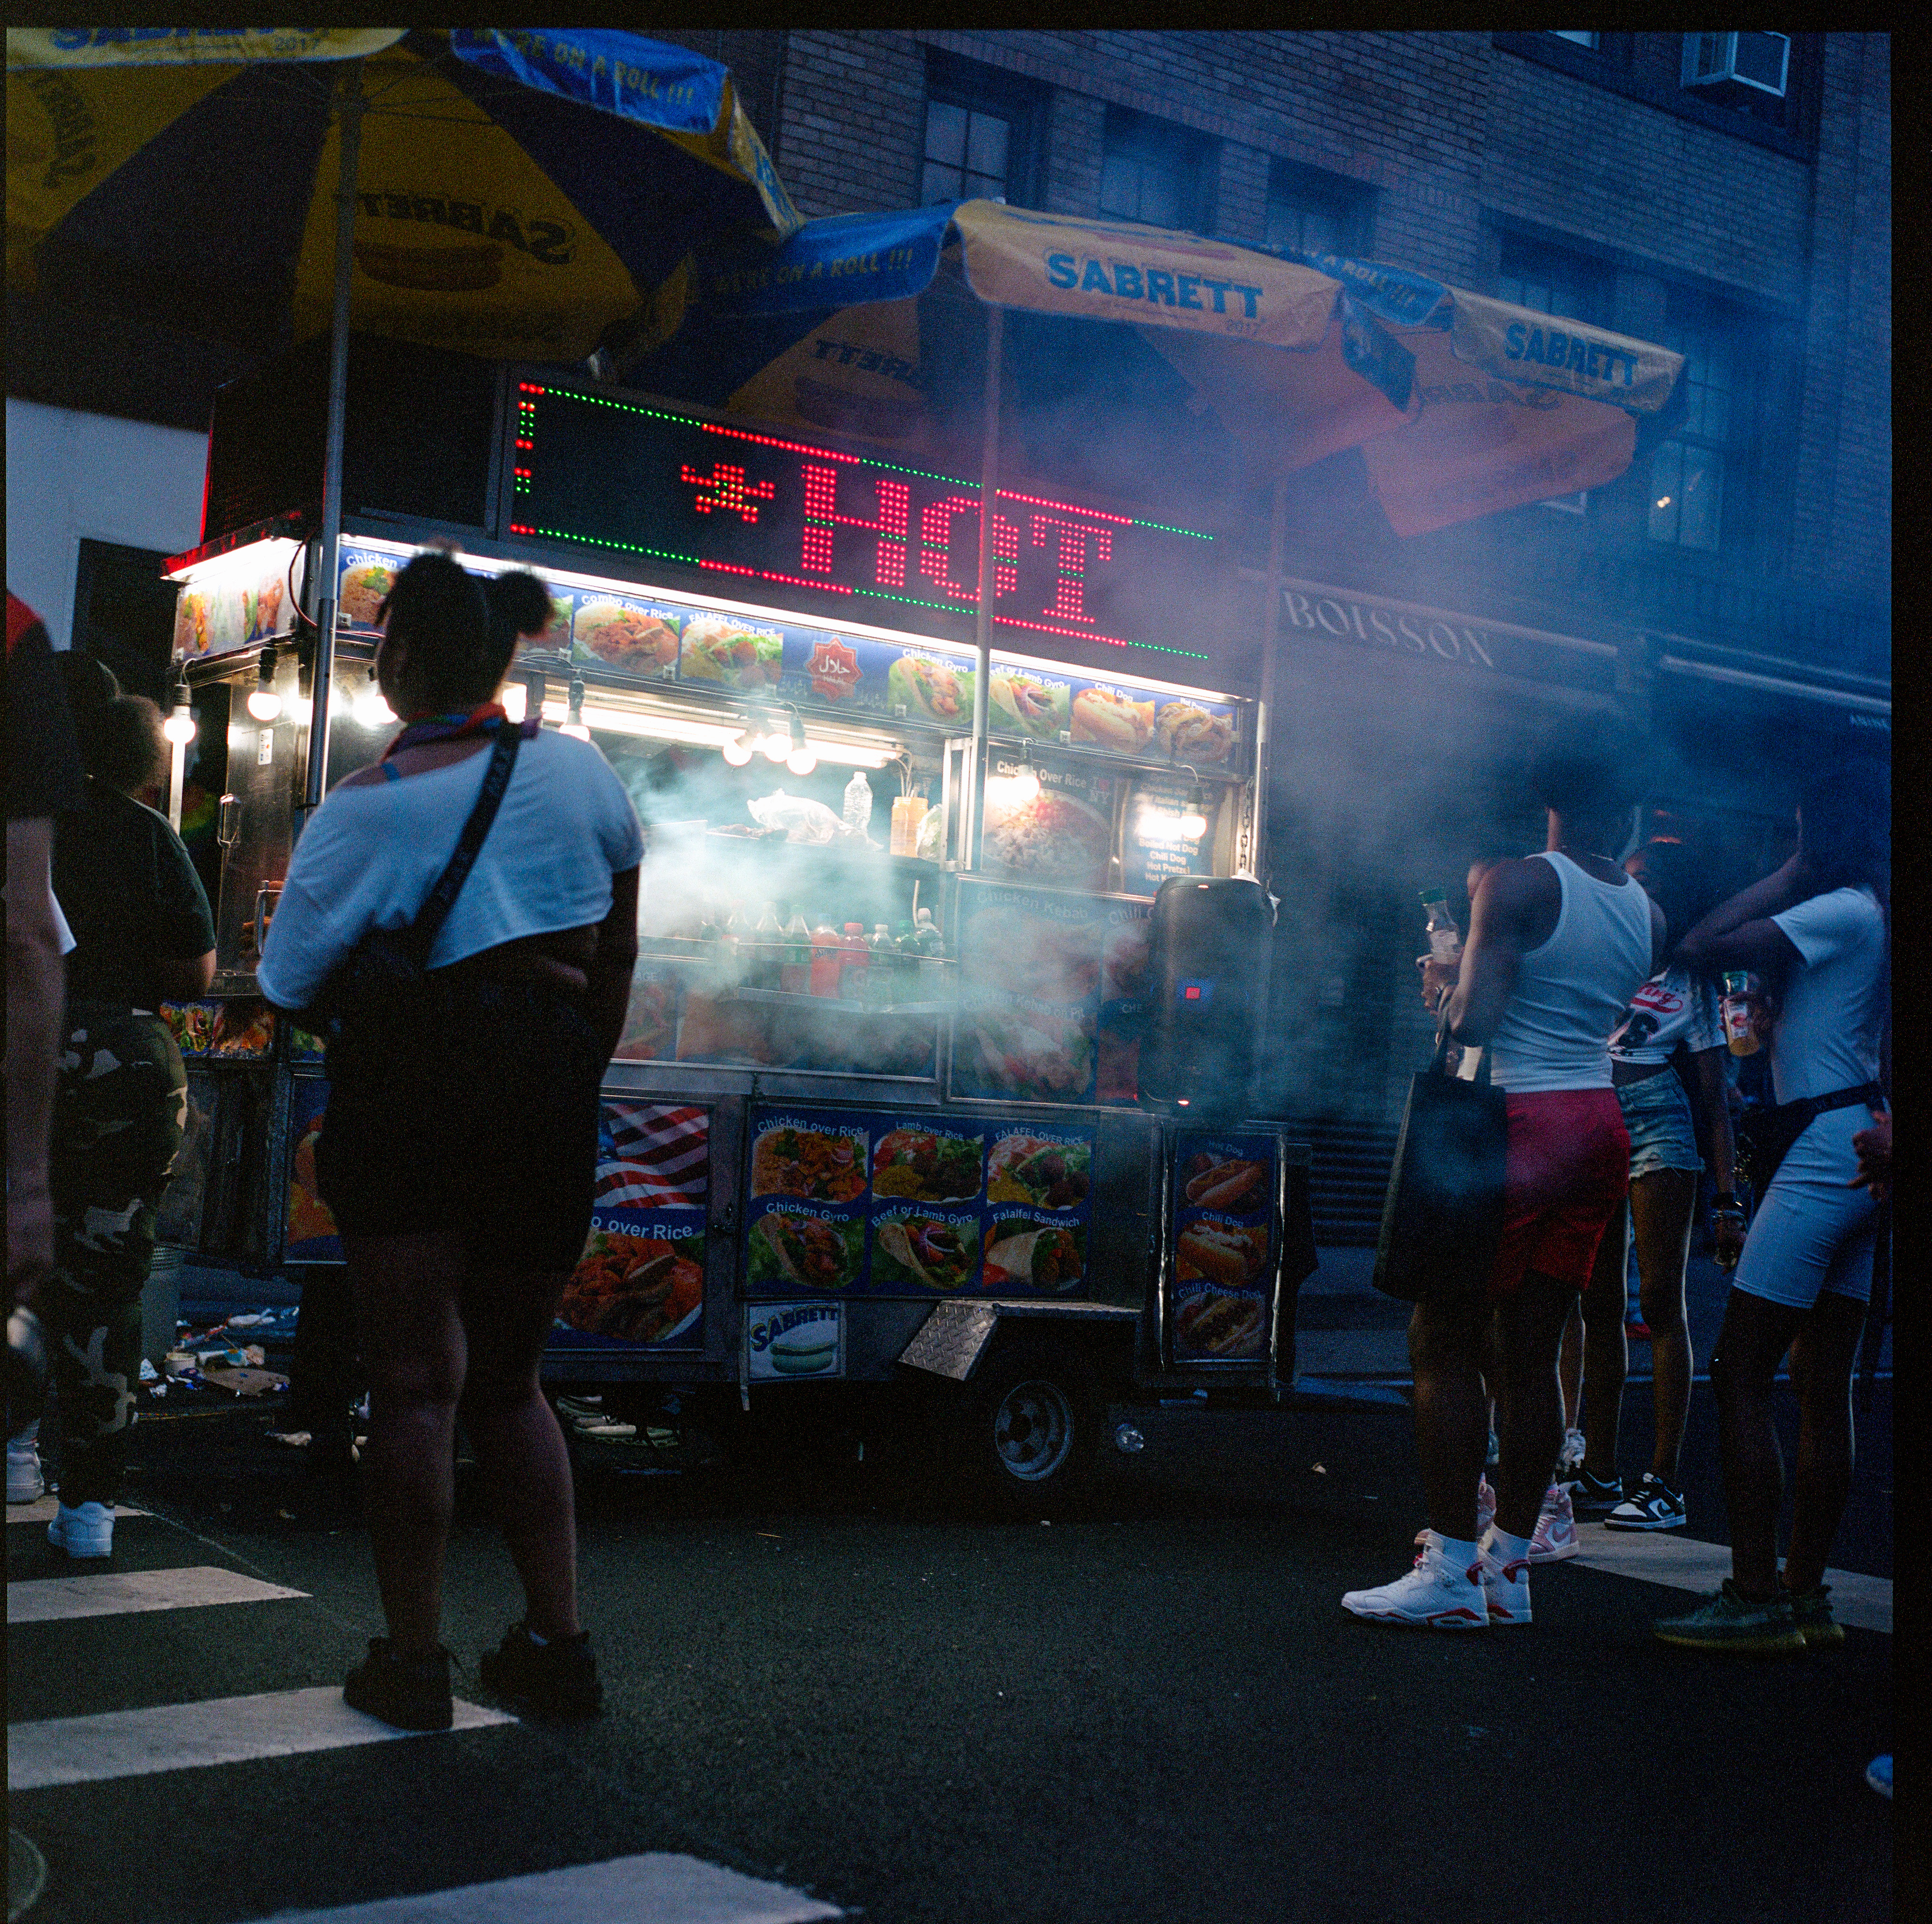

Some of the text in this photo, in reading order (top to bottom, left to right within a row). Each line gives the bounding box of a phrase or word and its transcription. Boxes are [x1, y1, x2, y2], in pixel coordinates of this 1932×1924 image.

[554, 42, 586, 71] ON
[592, 55, 607, 76] A
[614, 60, 660, 99] ROLL
[776, 264, 806, 284] ON
[810, 261, 823, 279] A
[830, 252, 879, 277] ROLL
[1046, 250, 1264, 319] SABRETT
[1504, 323, 1637, 386] SABRETT
[802, 464, 1112, 624] HOT
[346, 552, 397, 568] Chicken
[582, 594, 673, 620] Combo over Rice
[689, 614, 776, 636] FALAFEL OVER RICE
[1283, 590, 1494, 668] BOISSON
[819, 654, 851, 674] حلال
[903, 648, 968, 674] Chicken Gyro
[989, 665, 1065, 689] eef or Lamb Gyro
[1094, 681, 1134, 703] Chili Dog
[997, 760, 1087, 788] Chicn Over Rice
[1150, 850, 1186, 865] Chili Dog
[1182, 844, 1198, 856] Dog
[977, 890, 1039, 909] Chicken
[757, 1115, 864, 1137] Chicken over Rice
[895, 1121, 964, 1141] Lamb over Rice
[995, 1127, 1036, 1142] FALAFEL
[766, 1202, 850, 1224] Chicken Gyro
[871, 1205, 898, 1228] Beef
[914, 1206, 946, 1222] Lamb
[948, 1214, 973, 1227] Gyro
[1033, 1212, 1080, 1227] Sandwich
[1201, 1211, 1223, 1224] Chili
[608, 1220, 649, 1238] over
[653, 1224, 693, 1240] Rice
[751, 1305, 839, 1352] SABRETT
